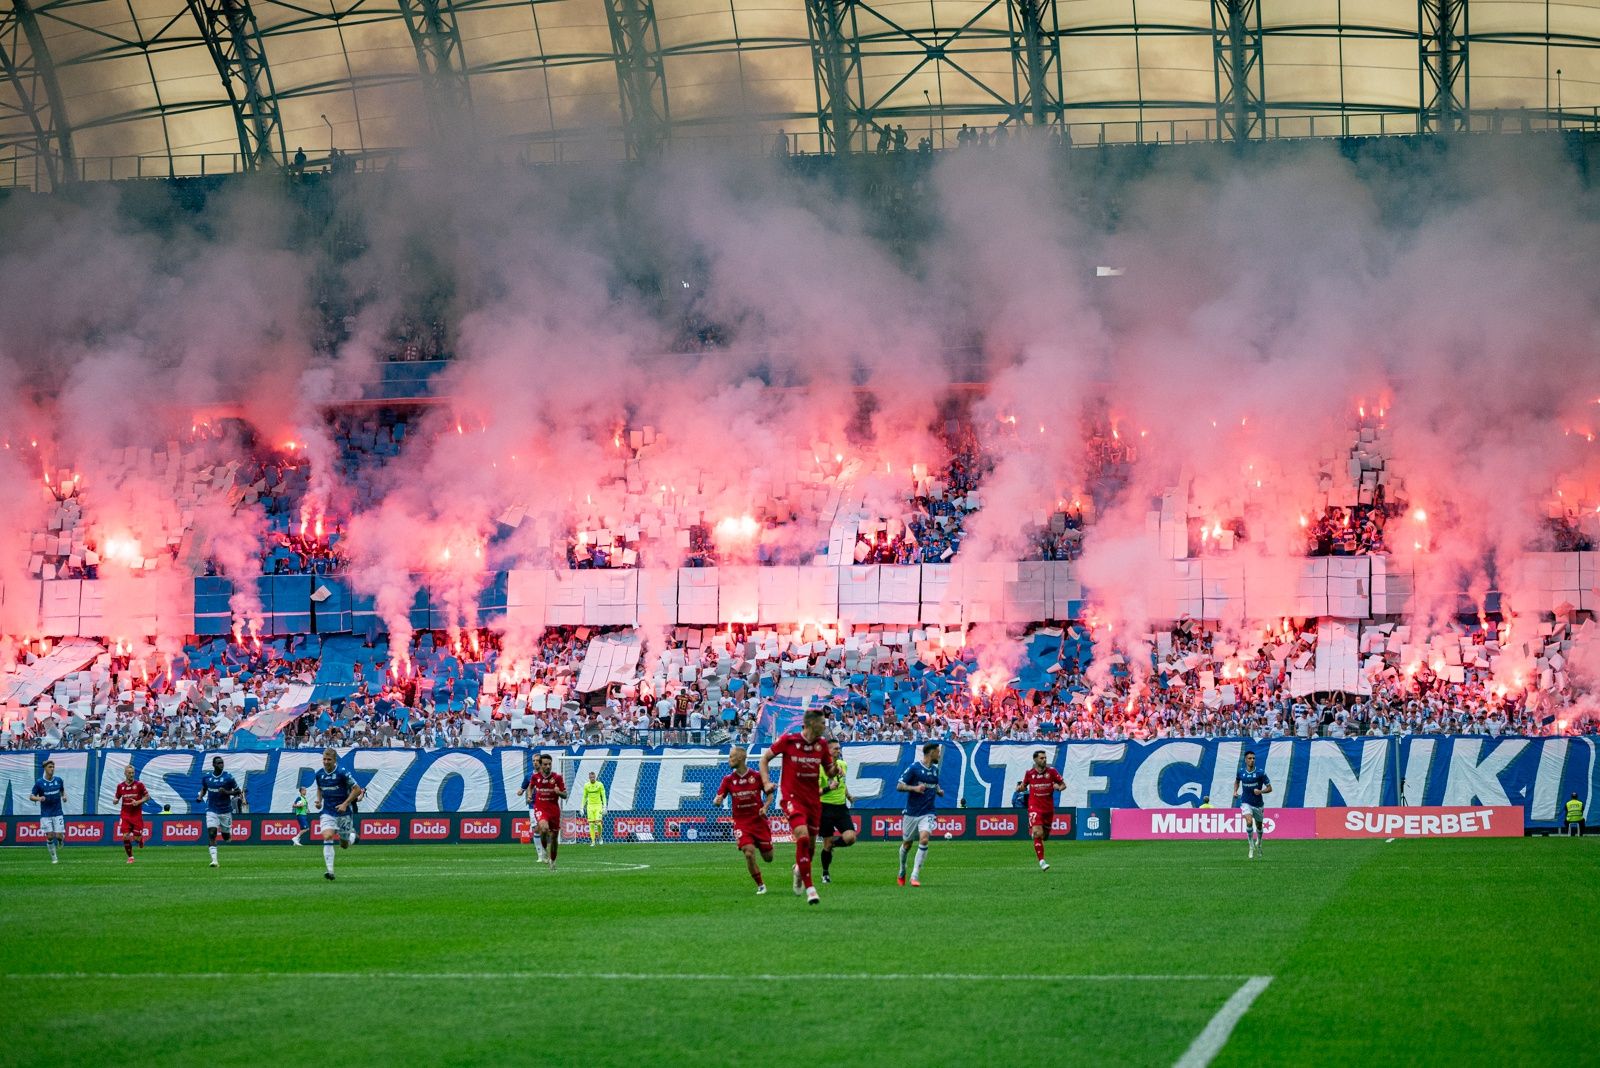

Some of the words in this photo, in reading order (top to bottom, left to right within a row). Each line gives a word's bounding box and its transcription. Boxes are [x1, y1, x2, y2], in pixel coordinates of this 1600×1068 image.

[617, 821, 651, 833] Duda
[771, 820, 790, 831] Du
[875, 820, 903, 830] Dud
[980, 819, 1015, 830] Duda
[1051, 818, 1067, 830] da
[1344, 809, 1494, 835] SUPERBET
[68, 825, 101, 837] Duda
[166, 824, 199, 836] Duda
[264, 824, 297, 835] Duda
[364, 823, 397, 835] Duda
[413, 823, 446, 834] Duda
[463, 823, 497, 834] Duda
